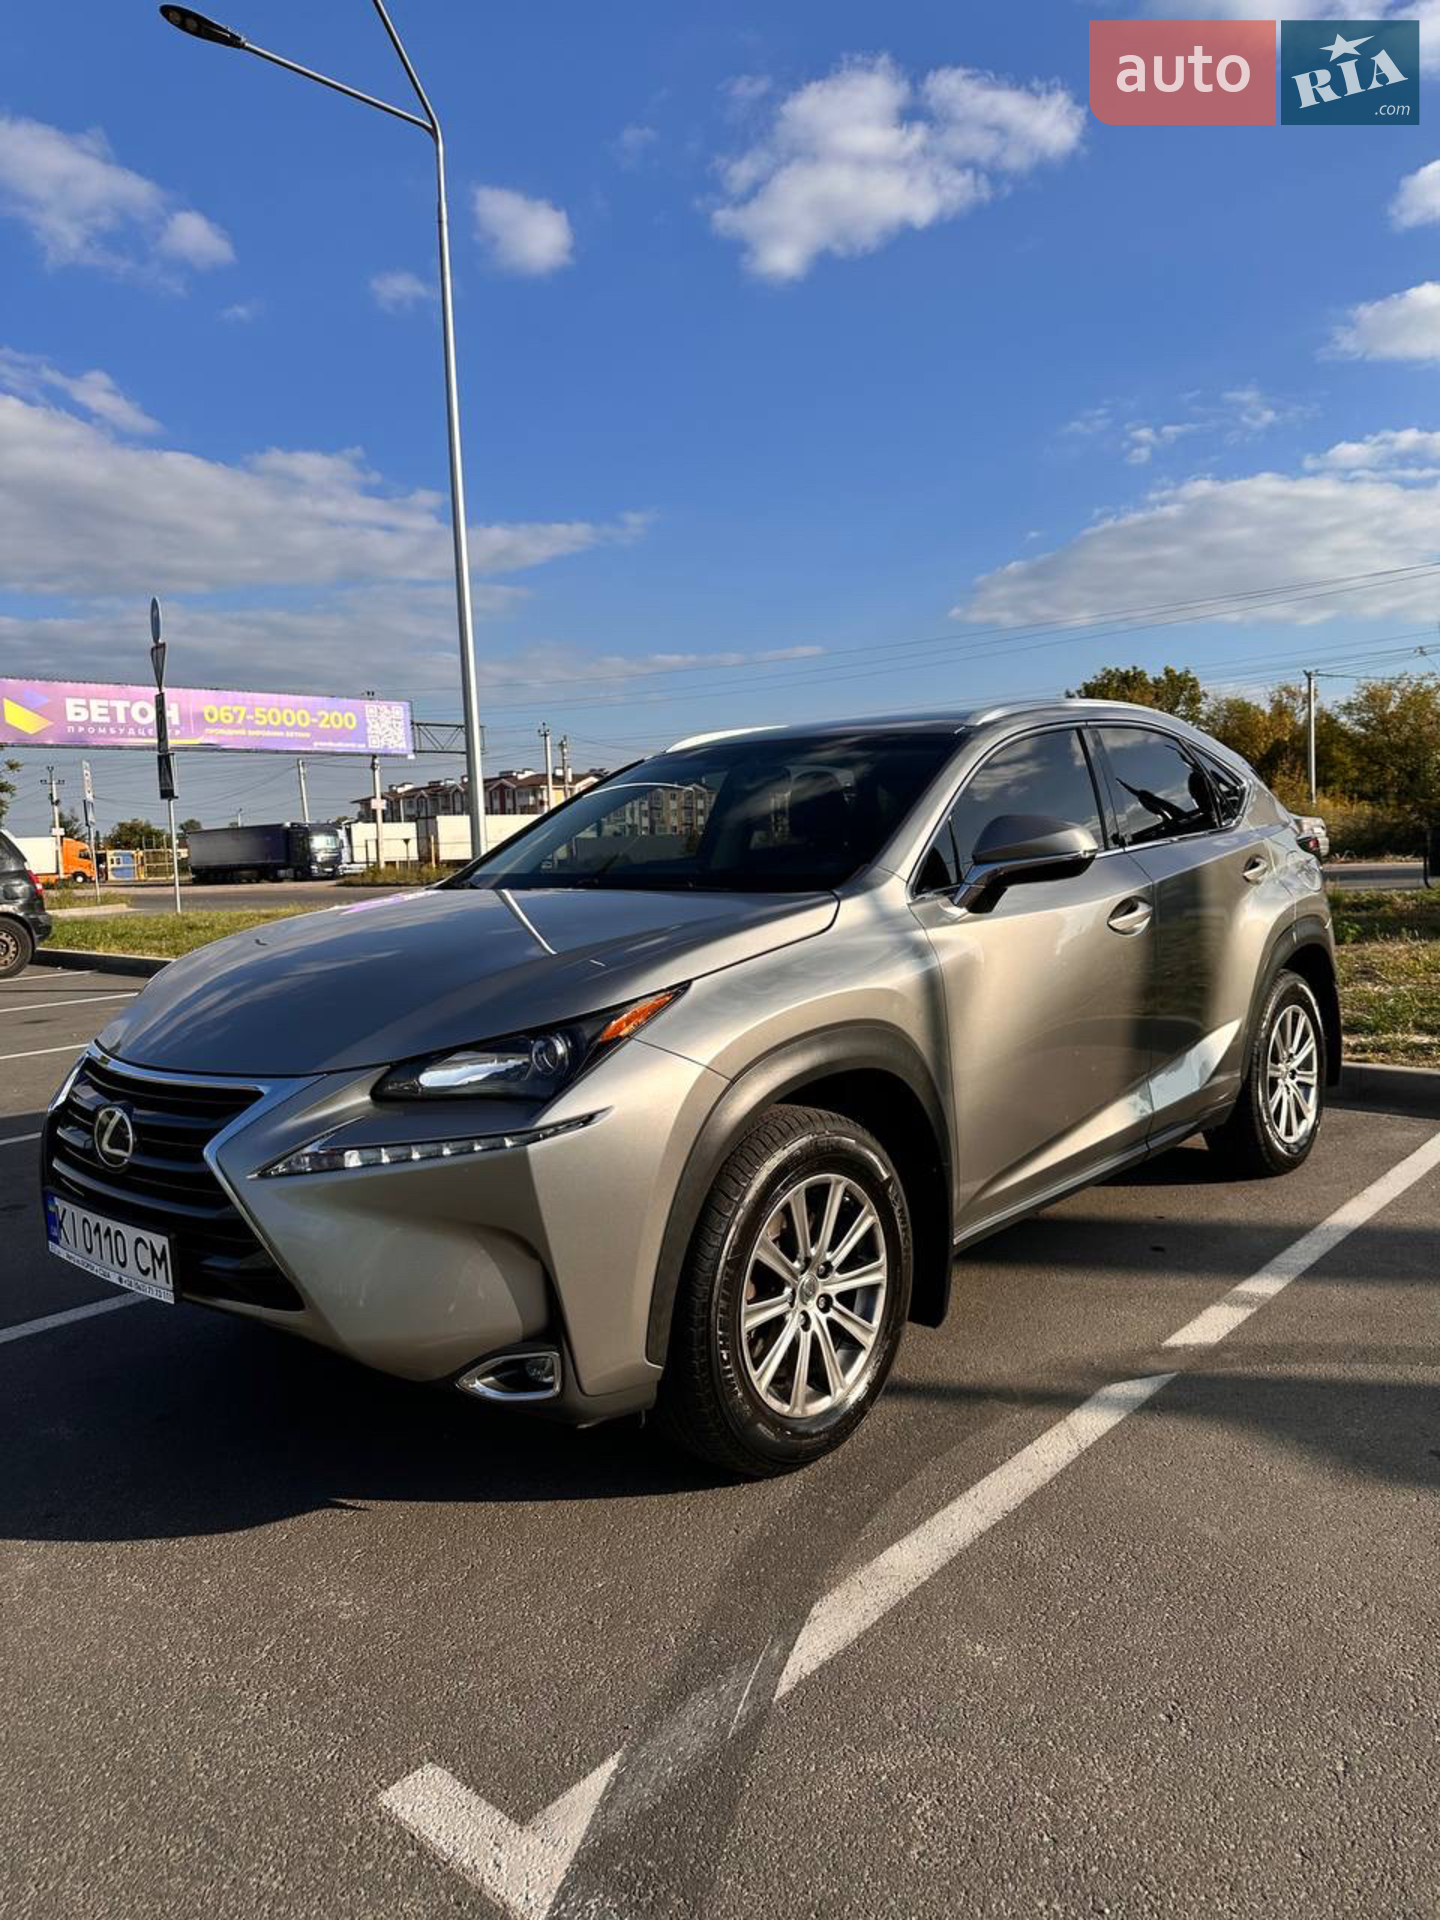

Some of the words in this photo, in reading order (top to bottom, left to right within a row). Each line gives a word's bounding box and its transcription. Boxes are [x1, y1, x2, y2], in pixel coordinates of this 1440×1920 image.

[65, 697, 180, 725] БЕТОН
[203, 704, 357, 730] 067-5000-200
[66, 725, 181, 736] ПРОМБУДЦЕТР
[55, 1204, 77, 1248] KI
[82, 1217, 128, 1268] 0110
[134, 1237, 170, 1284] CM
[716, 1264, 743, 1399] MICHELIN
